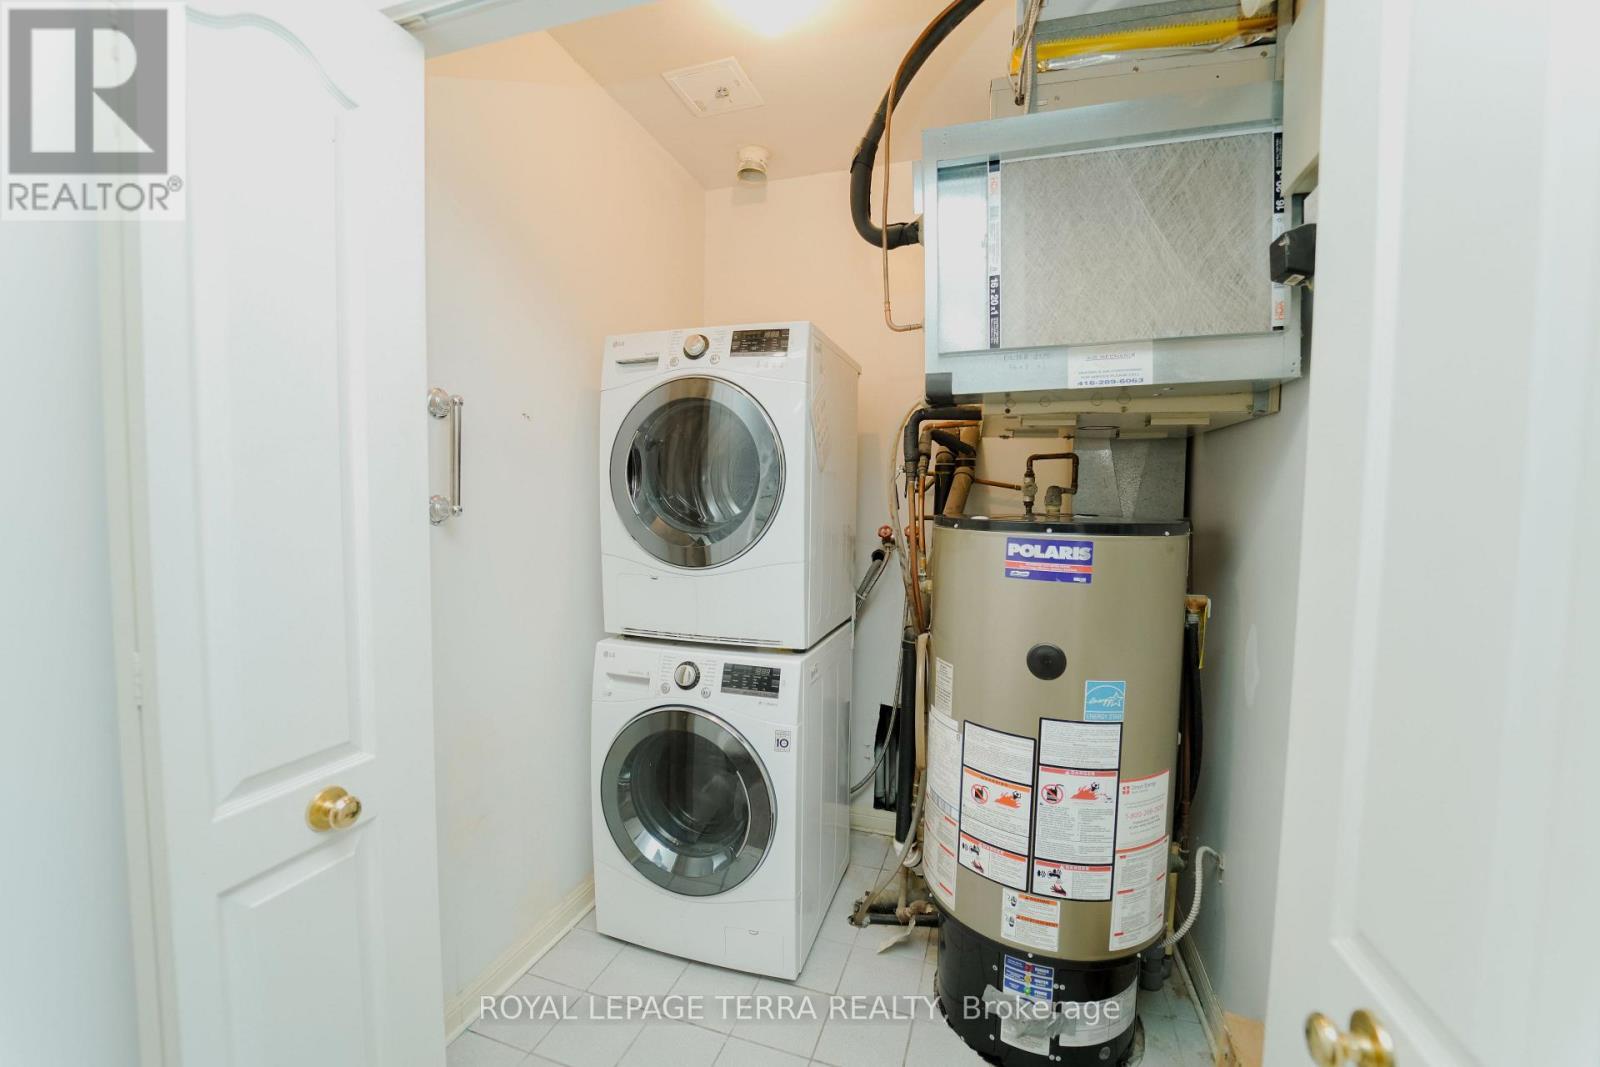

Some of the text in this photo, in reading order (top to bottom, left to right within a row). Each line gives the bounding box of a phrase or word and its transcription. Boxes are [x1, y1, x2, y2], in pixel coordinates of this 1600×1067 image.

[990, 277, 999, 288] 16
[990, 294, 999, 306] 20
[1007, 543, 1092, 560] POLARIS
